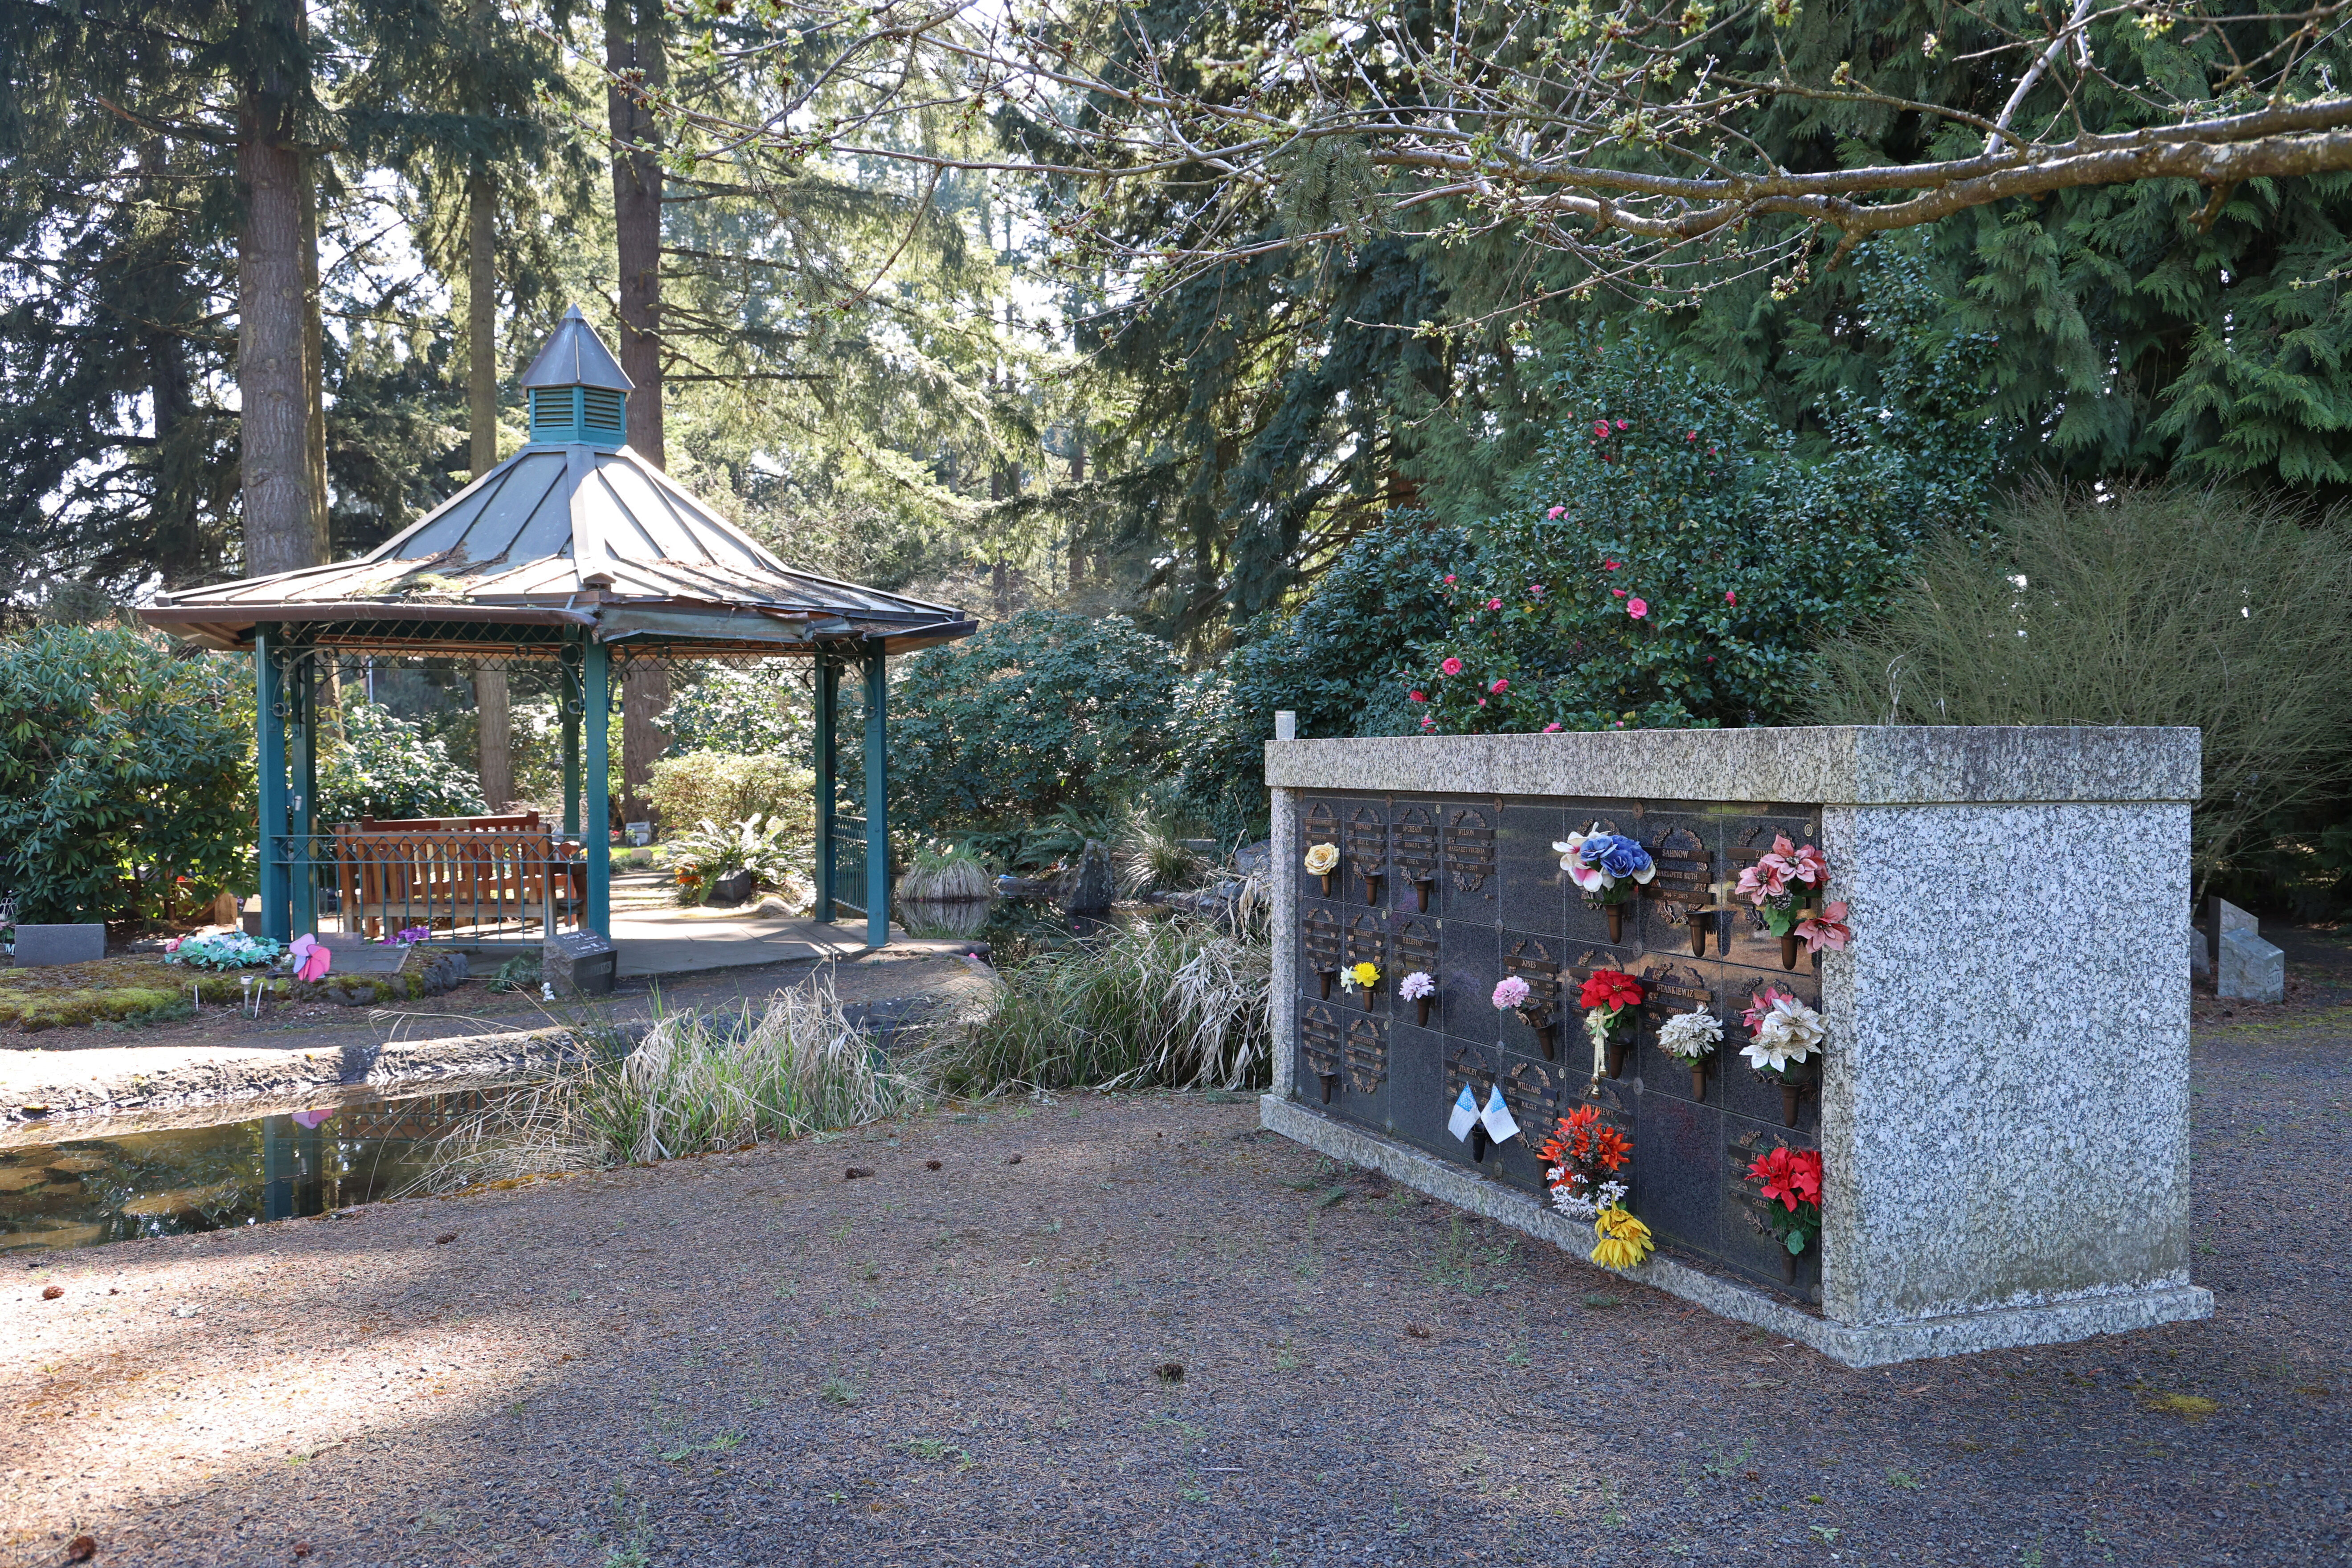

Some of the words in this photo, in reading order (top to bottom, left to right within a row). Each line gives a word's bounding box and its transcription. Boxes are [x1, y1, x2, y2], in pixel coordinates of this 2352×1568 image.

[1458, 829, 1474, 837] WILSON
[1661, 849, 1689, 859] SAHNOW
[1656, 870, 1683, 879] HARLOTTE
[1684, 871, 1698, 880] RUTH
[1522, 959, 1537, 969] JONES
[1522, 978, 1538, 987] IRGINIA
[1656, 983, 1695, 998] STANKIEWIZ
[1524, 996, 1540, 1005] GORDON
[1666, 1006, 1684, 1015] SOPHIE
[1458, 1064, 1478, 1076] STANLEY
[1517, 1080, 1542, 1095] WILLIAMS
[1523, 1119, 1535, 1129] MARY
